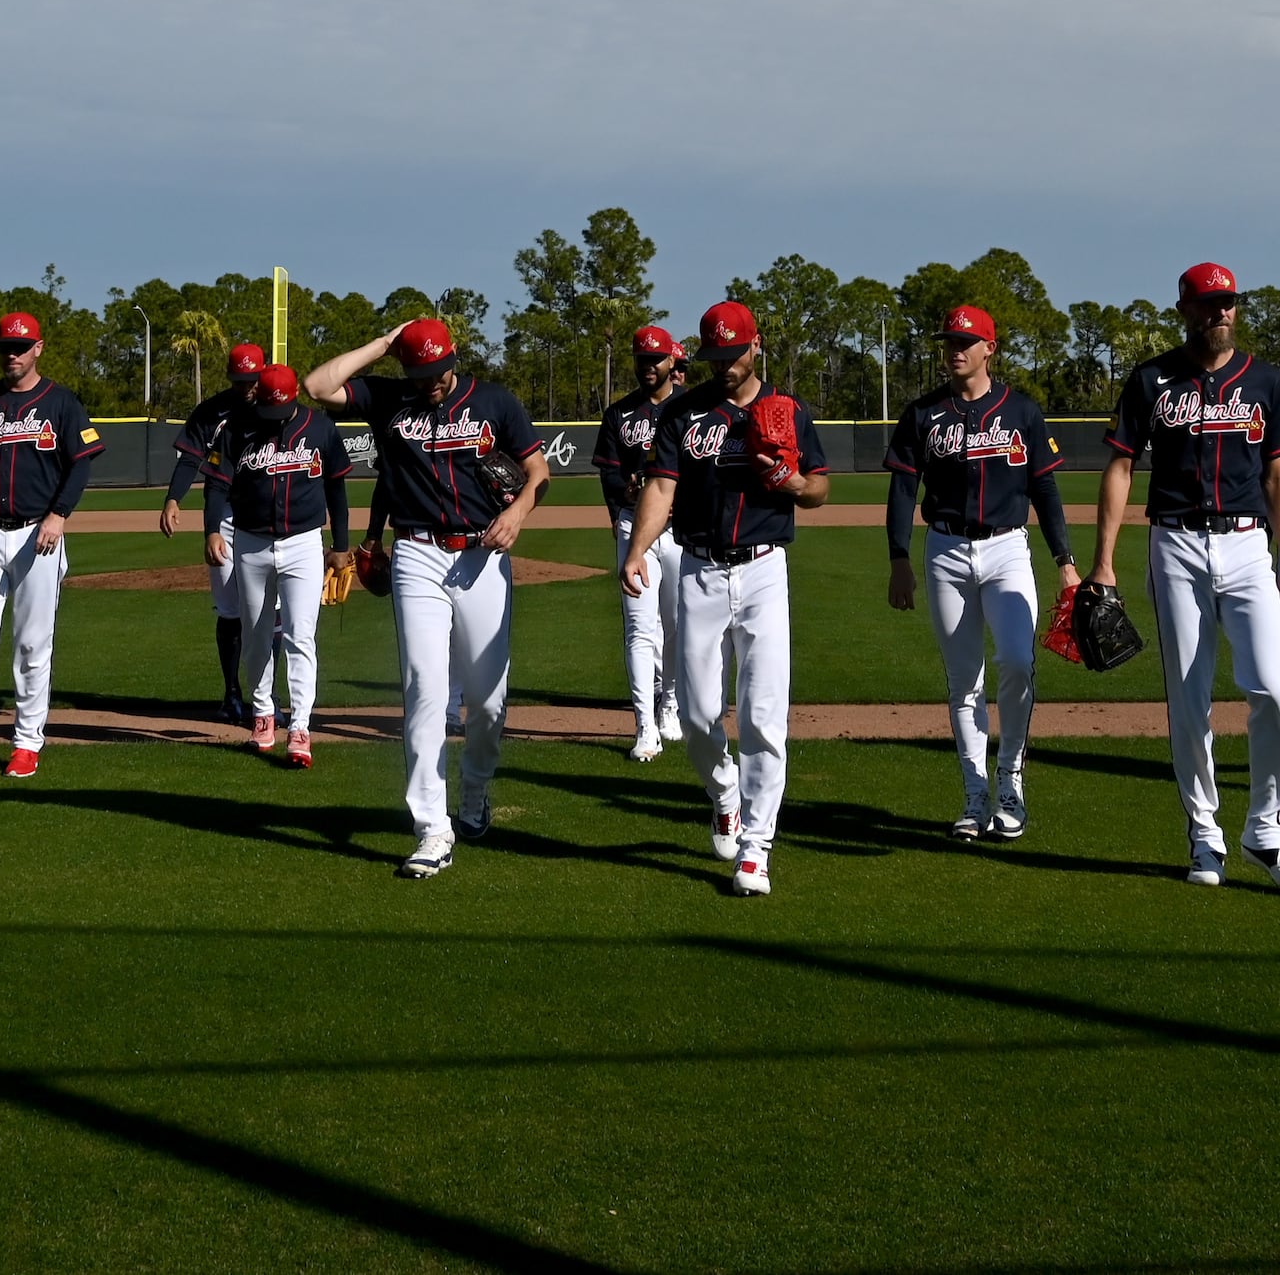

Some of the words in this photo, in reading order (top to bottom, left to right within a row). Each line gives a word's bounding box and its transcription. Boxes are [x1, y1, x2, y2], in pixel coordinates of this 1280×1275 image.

[387, 407, 480, 441] Atlanta
[1151, 387, 1251, 429] Atlanta
[236, 437, 313, 473] Atlanta
[925, 416, 1011, 462] Atlanta
